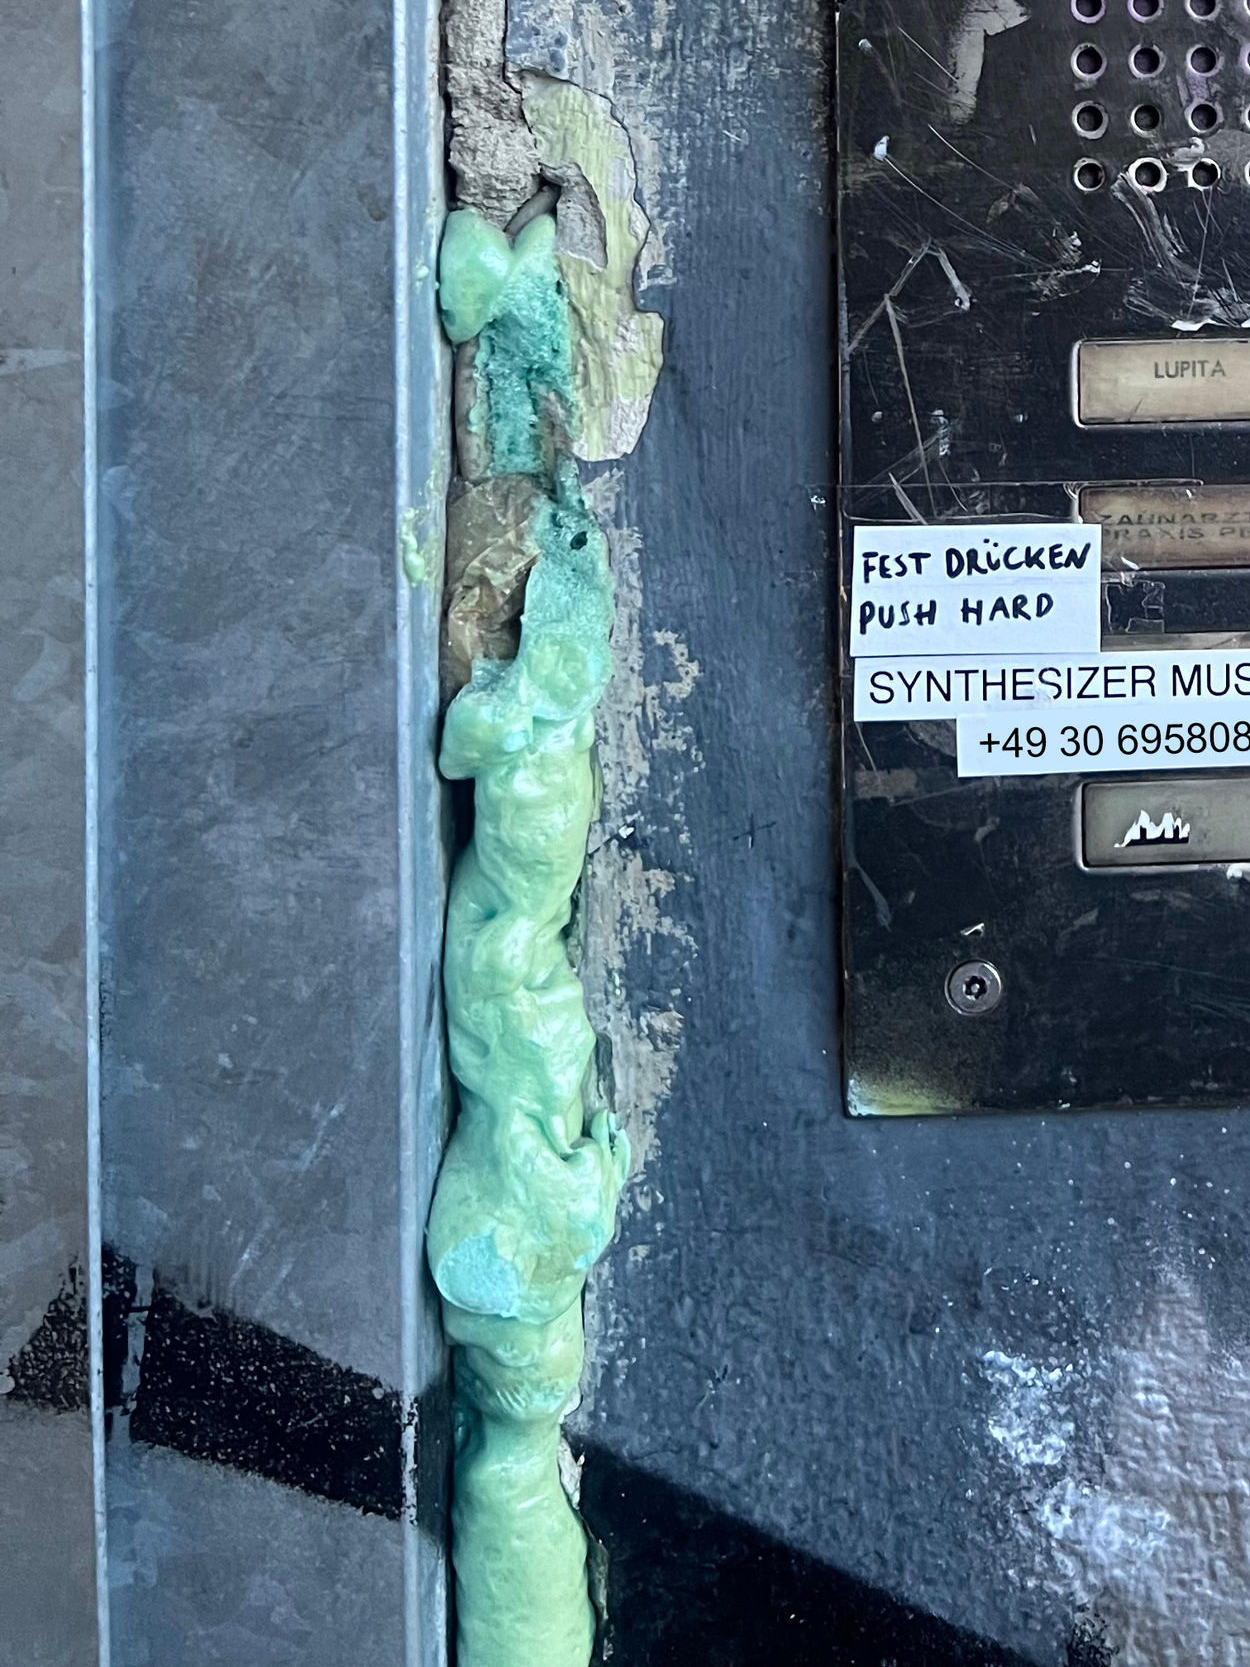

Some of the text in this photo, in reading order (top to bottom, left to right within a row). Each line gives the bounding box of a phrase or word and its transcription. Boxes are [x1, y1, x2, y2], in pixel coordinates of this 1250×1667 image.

[1153, 359, 1228, 380] LUPITA
[862, 538, 1092, 584] FEST DRÜCKEN
[859, 592, 1054, 635] PUSH HARD
[868, 664, 1156, 705] SYNTHESIZER
[978, 725, 1047, 758] +49
[1059, 724, 1104, 757] 30
